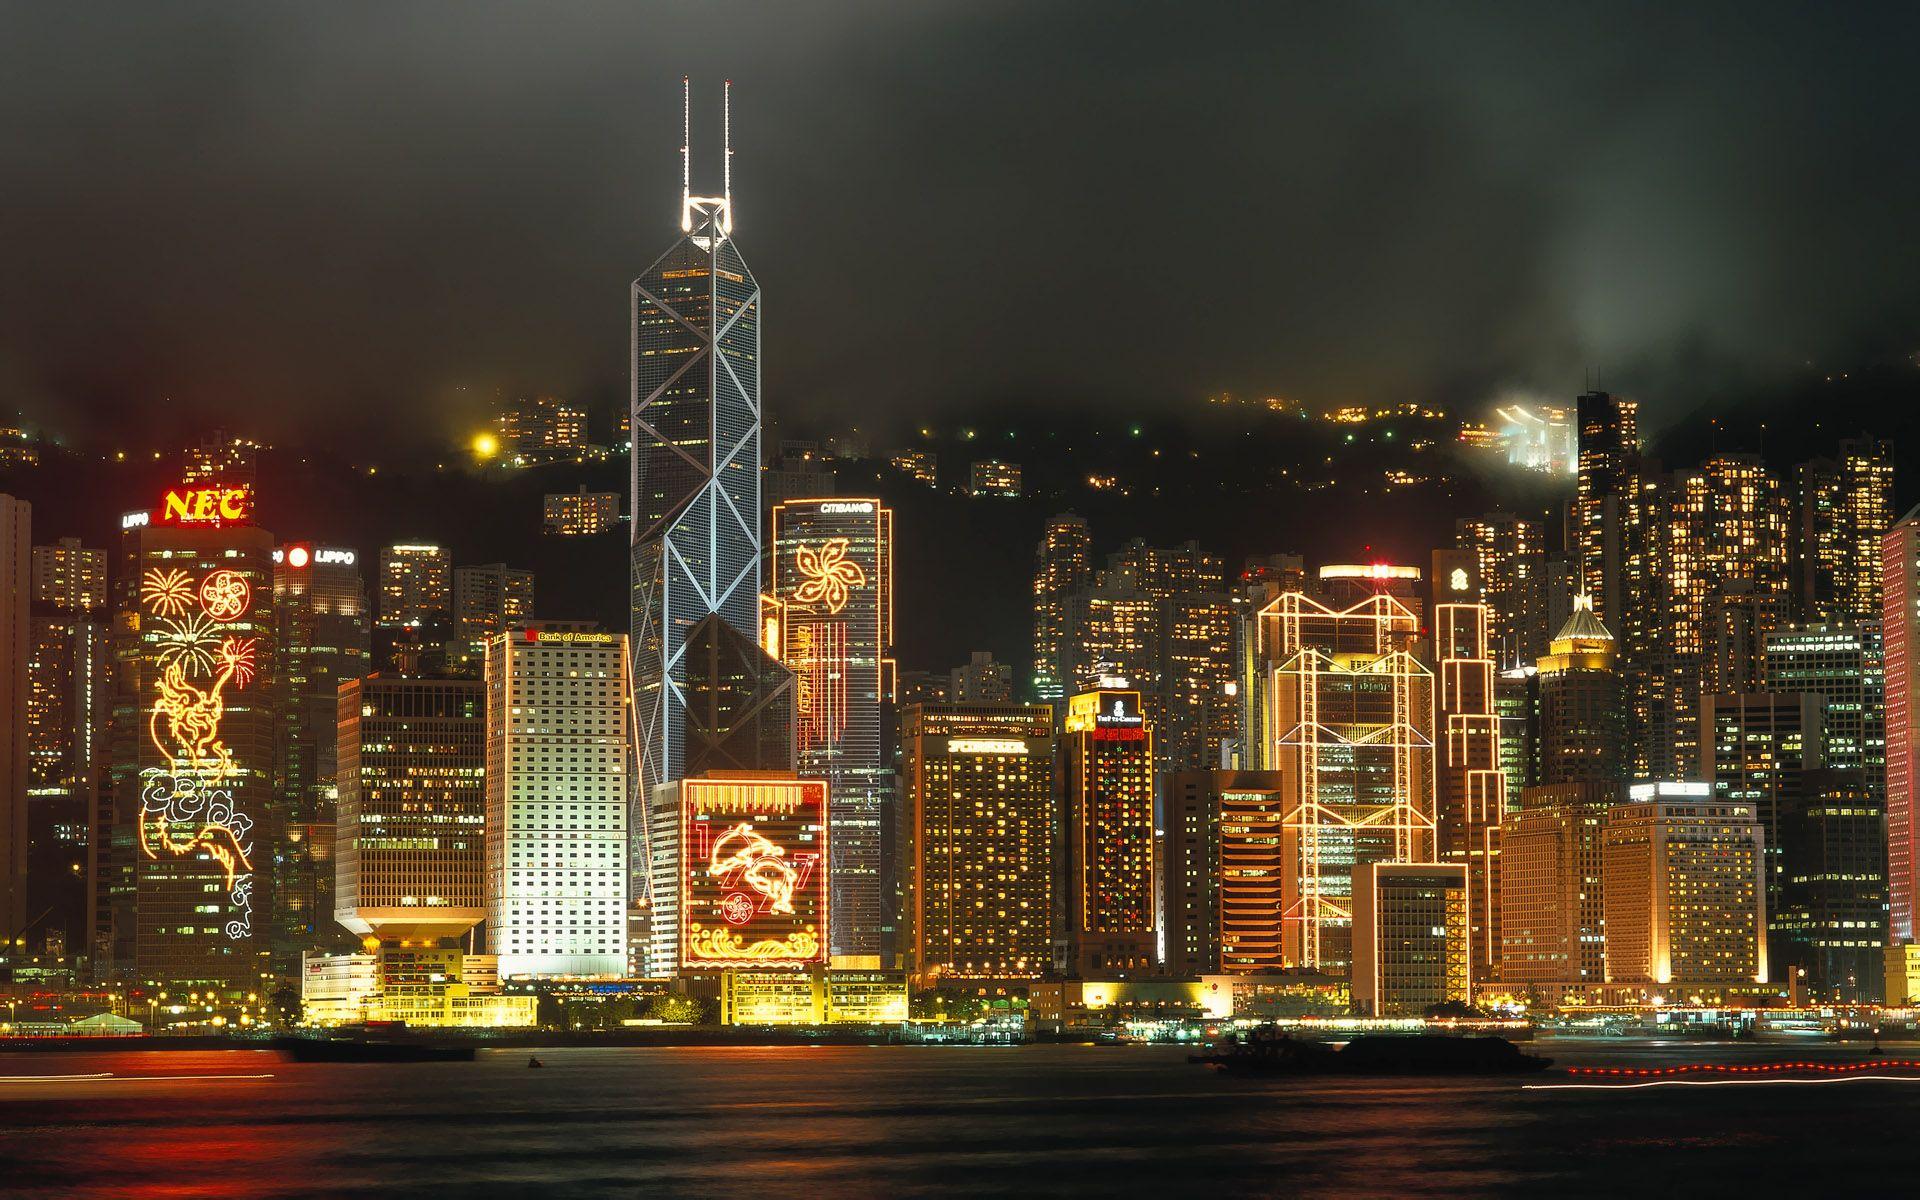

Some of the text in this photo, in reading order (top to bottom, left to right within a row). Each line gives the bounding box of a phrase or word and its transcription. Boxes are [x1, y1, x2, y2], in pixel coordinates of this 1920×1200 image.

[164, 489, 245, 520] NEC
[122, 512, 149, 528] LIPPO
[314, 549, 355, 565] LIPPO
[538, 631, 613, 643] Bank of America
